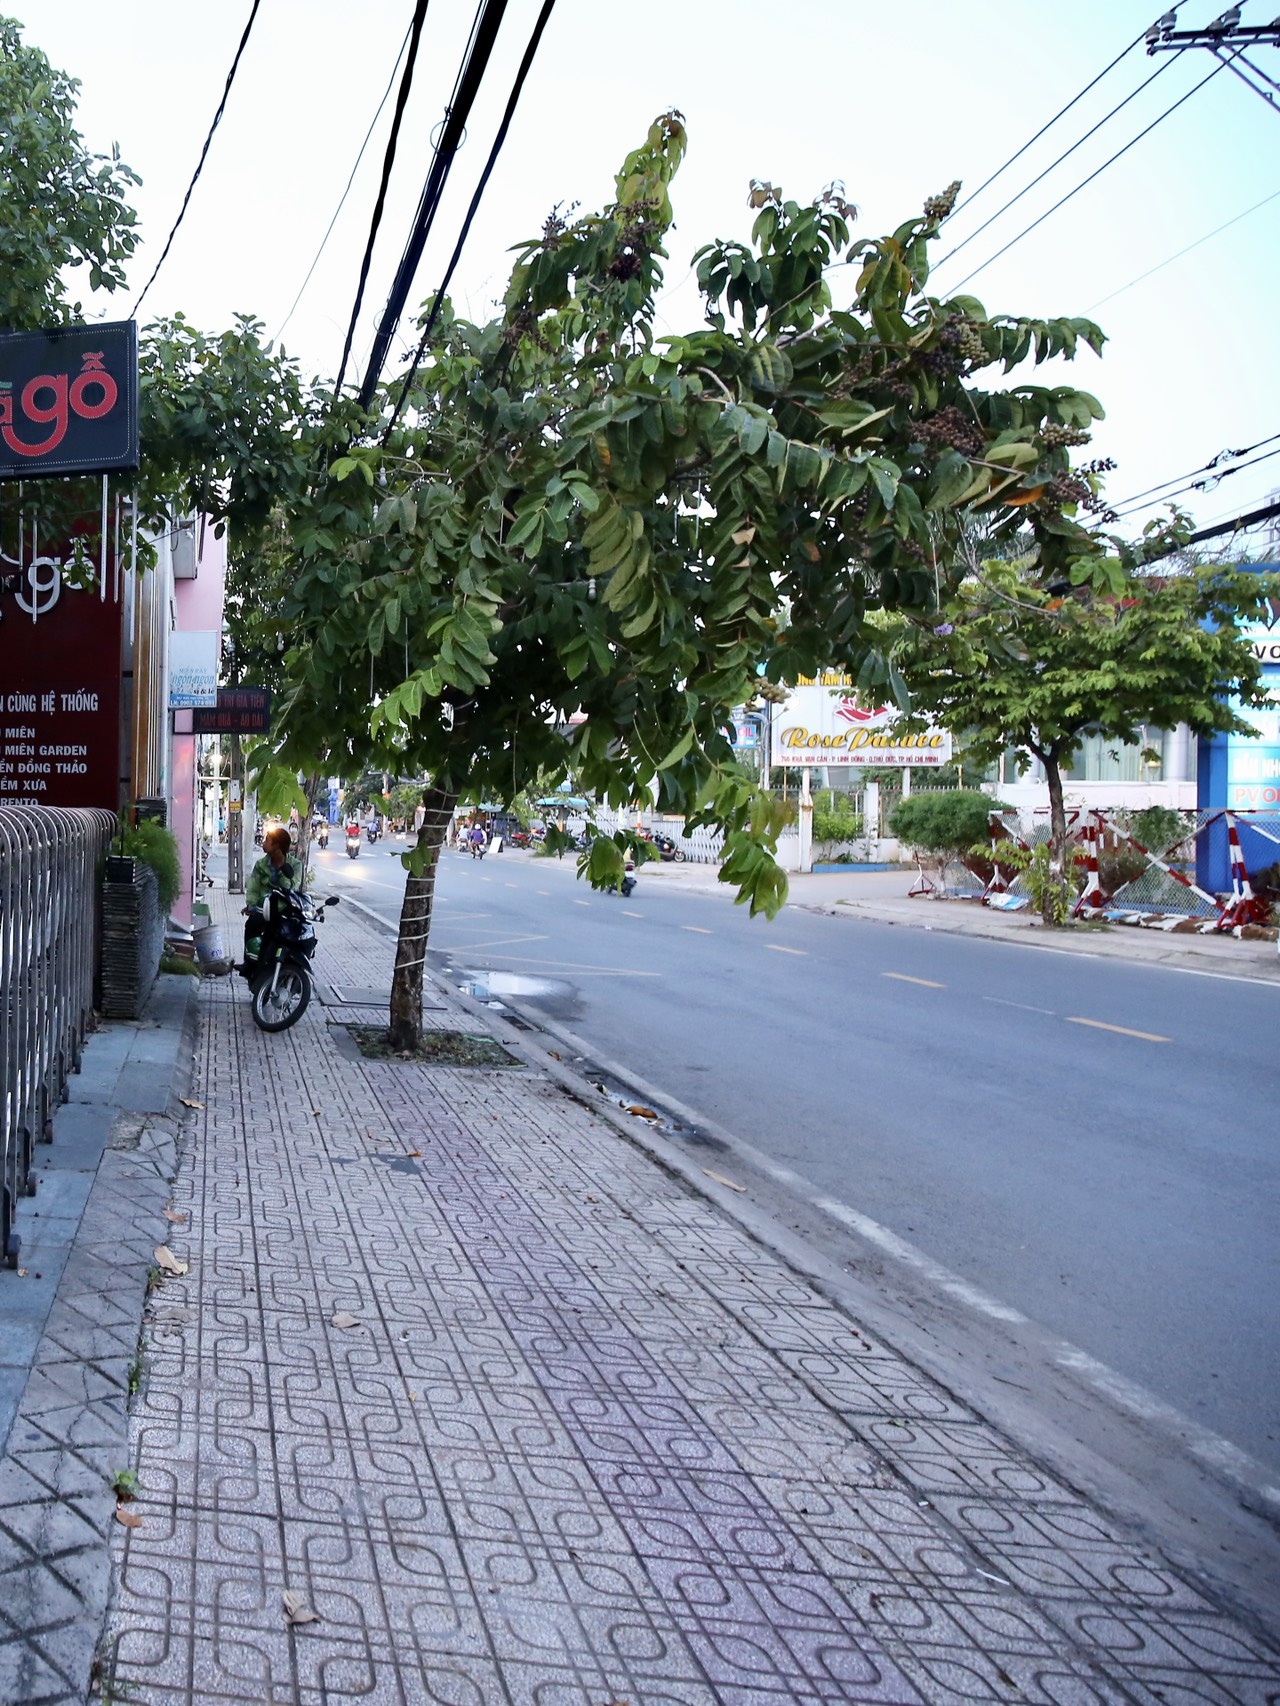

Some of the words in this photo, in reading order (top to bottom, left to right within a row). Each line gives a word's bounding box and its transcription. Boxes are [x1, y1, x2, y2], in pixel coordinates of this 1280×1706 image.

[1, 351, 118, 457] gỗ
[7, 691, 36, 713] CÙNG
[41, 690, 56, 715] HỆ
[61, 688, 99, 712] THỐNG
[5, 725, 36, 738] MIÊN
[781, 727, 846, 750] Rose
[5, 743, 35, 756] MIÊN
[39, 745, 87, 756] GARDEN
[18, 758, 51, 773] ĐỒNG
[55, 759, 88, 774] THẢO
[23, 779, 47, 790] XƯA
